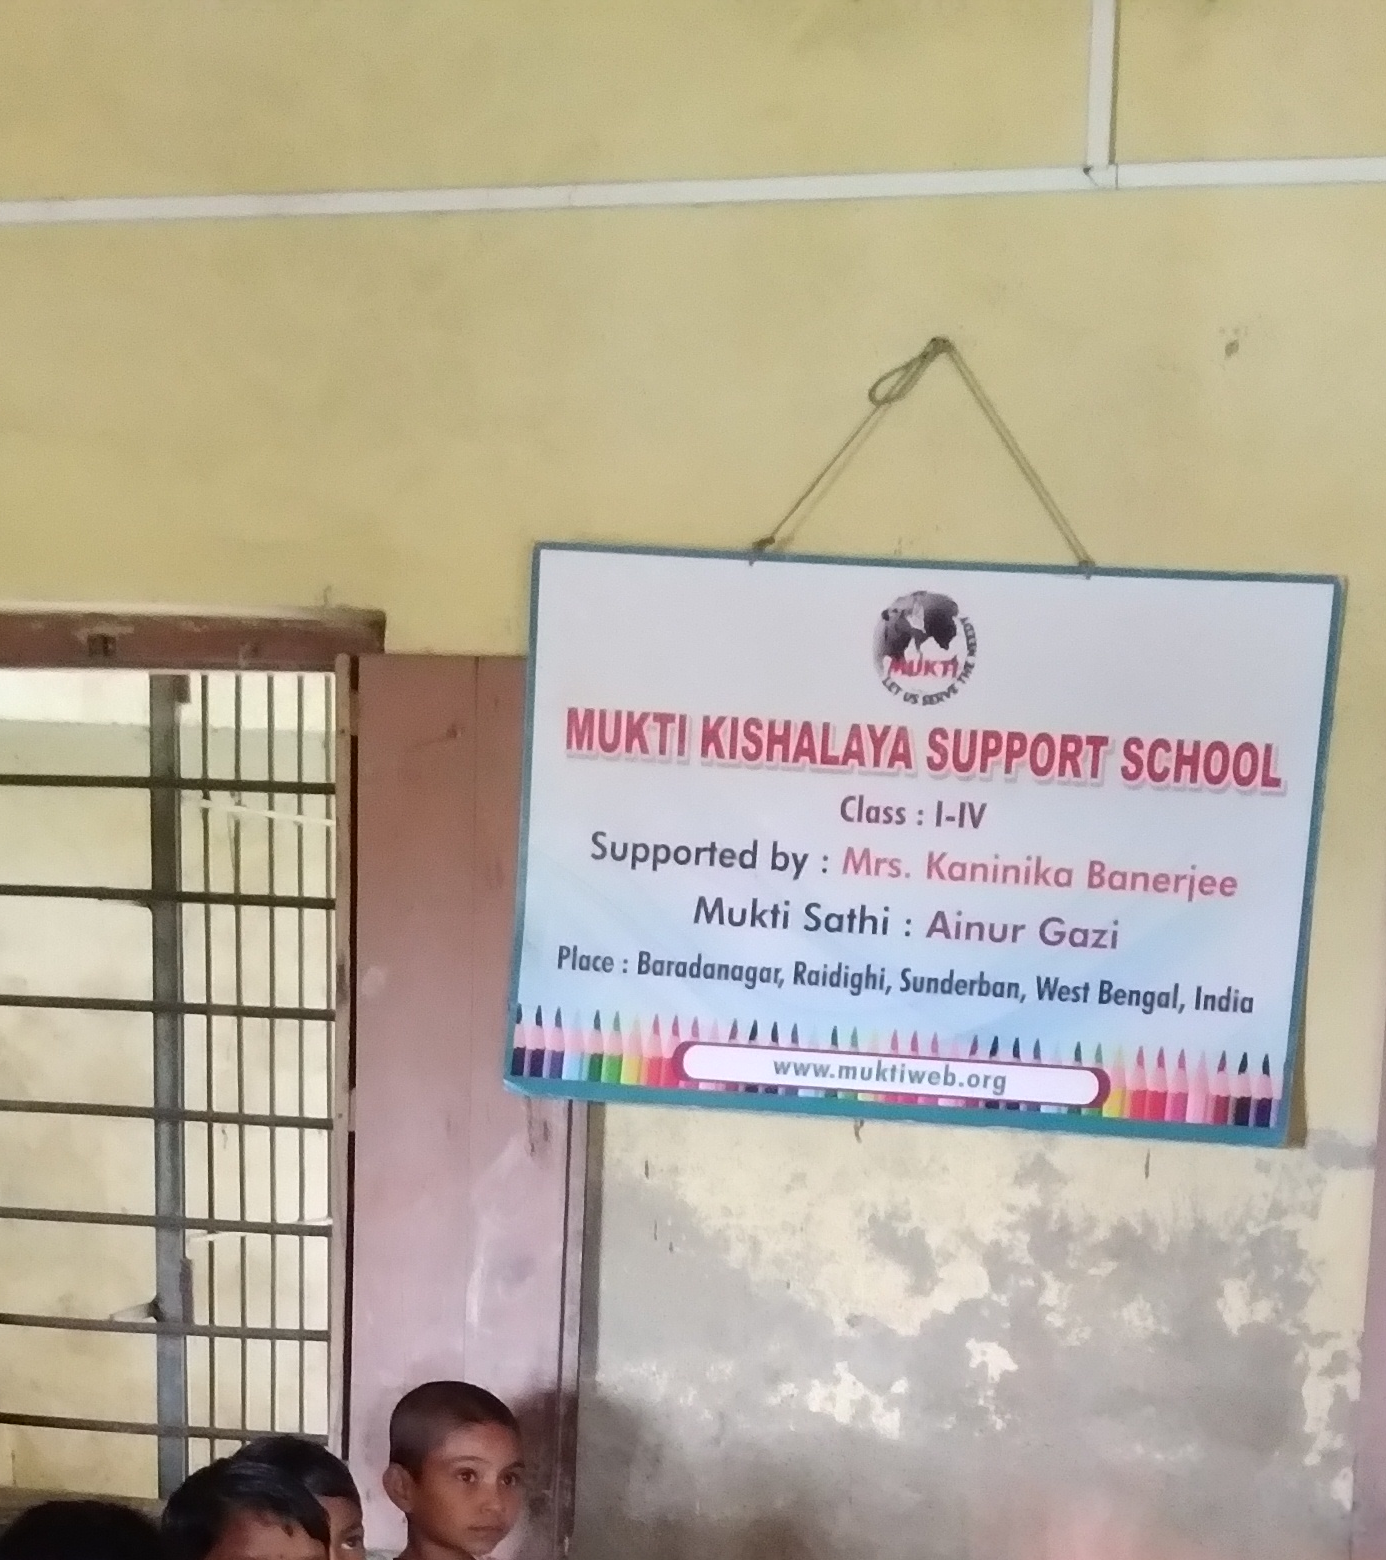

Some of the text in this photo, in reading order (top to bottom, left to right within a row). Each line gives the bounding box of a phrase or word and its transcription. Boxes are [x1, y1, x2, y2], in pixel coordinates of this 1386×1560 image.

[887, 655, 959, 679] MUKTI
[566, 707, 1282, 788] MUKTI KISHALAYA SUPPORT SCHOOL
[840, 795, 906, 825] Class
[935, 801, 987, 829] I-IV
[591, 831, 758, 872] Supported
[771, 841, 809, 881] by
[842, 846, 911, 879] Mrs.
[926, 850, 1074, 888] Kaninika
[1087, 860, 1238, 902] Banerjee
[693, 896, 790, 930] Mukti
[803, 902, 890, 936] Sathi
[925, 910, 1026, 944] Ainur
[1038, 916, 1119, 950] Gazi
[557, 945, 614, 974] Place
[637, 951, 785, 990] Baradanagar,
[793, 961, 892, 996] Raidighi,
[899, 967, 1027, 1004] Sunderban,
[1035, 975, 1090, 1004] West
[1098, 979, 1185, 1015] Bengal,
[1194, 985, 1255, 1015] India
[773, 1059, 1007, 1096] www.muktiweb.org
